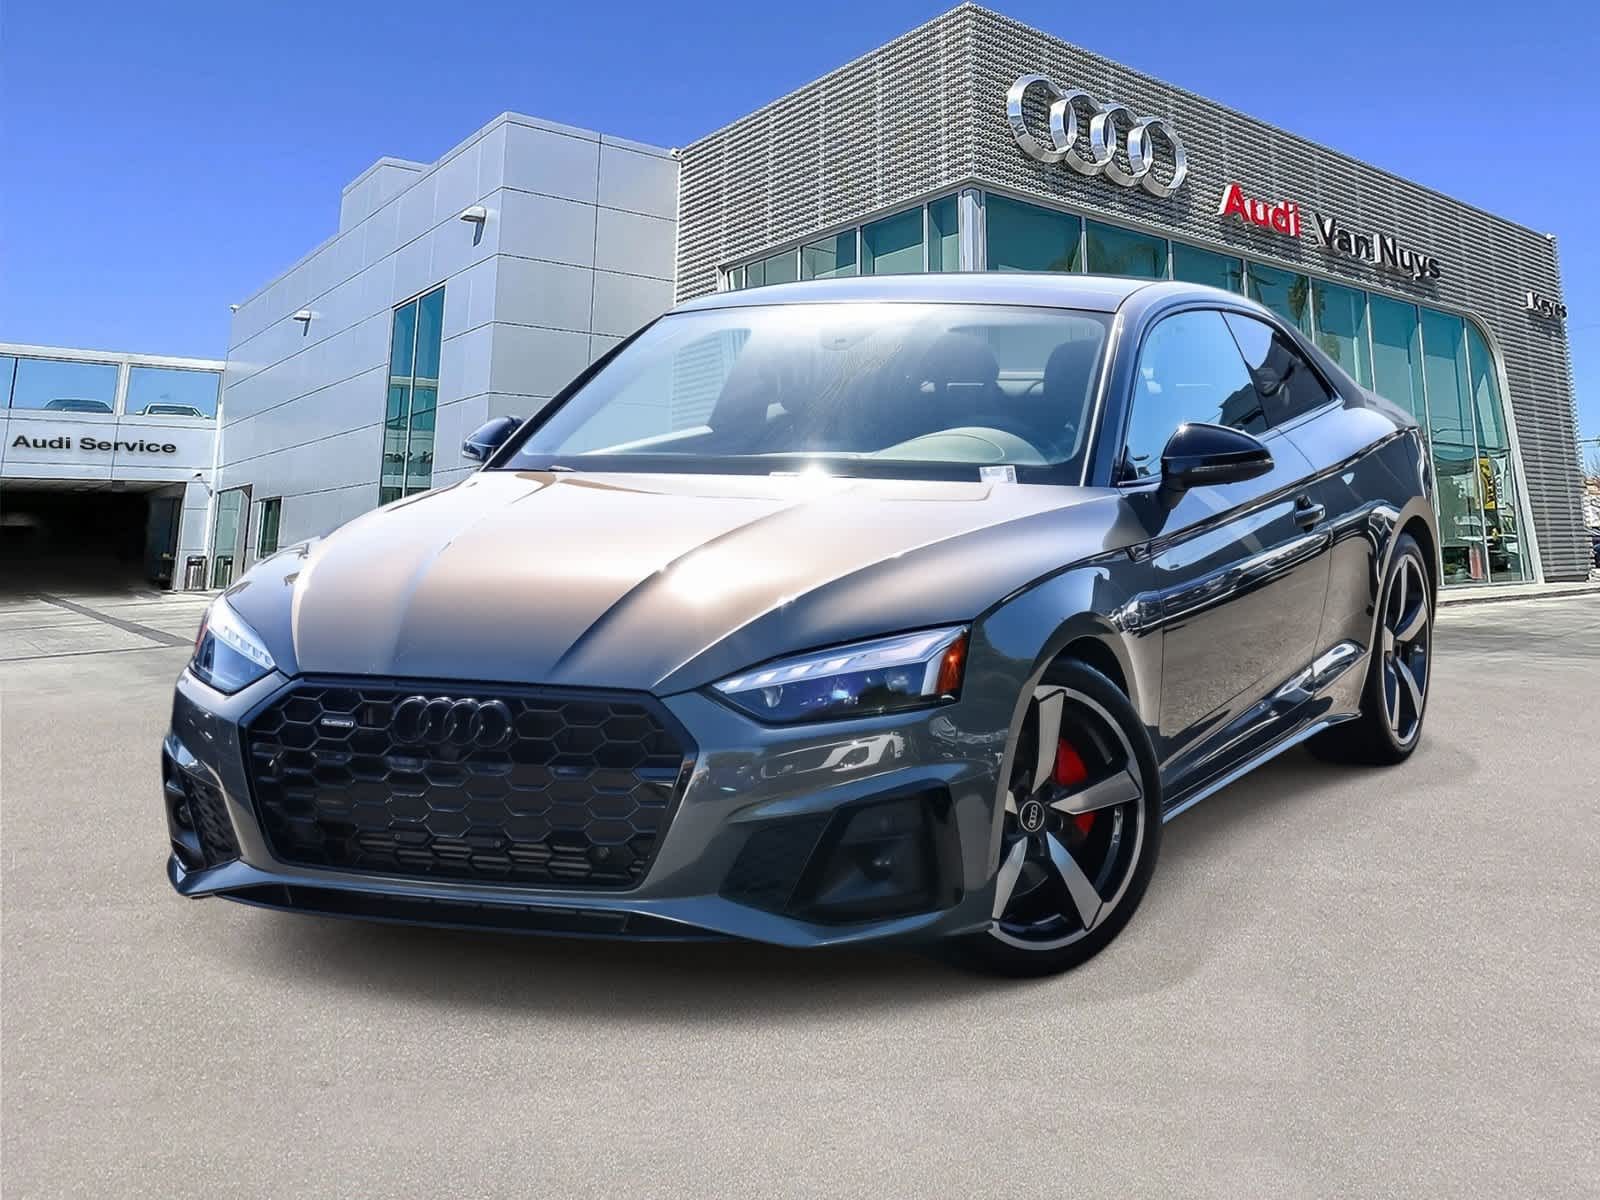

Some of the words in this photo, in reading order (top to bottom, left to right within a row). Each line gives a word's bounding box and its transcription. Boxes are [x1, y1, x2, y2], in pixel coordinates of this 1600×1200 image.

[1218, 181, 1302, 238] Audi
[1311, 212, 1370, 259] Van
[1373, 233, 1442, 280] Nuys
[12, 434, 72, 450] Audi
[80, 437, 177, 454] Service
